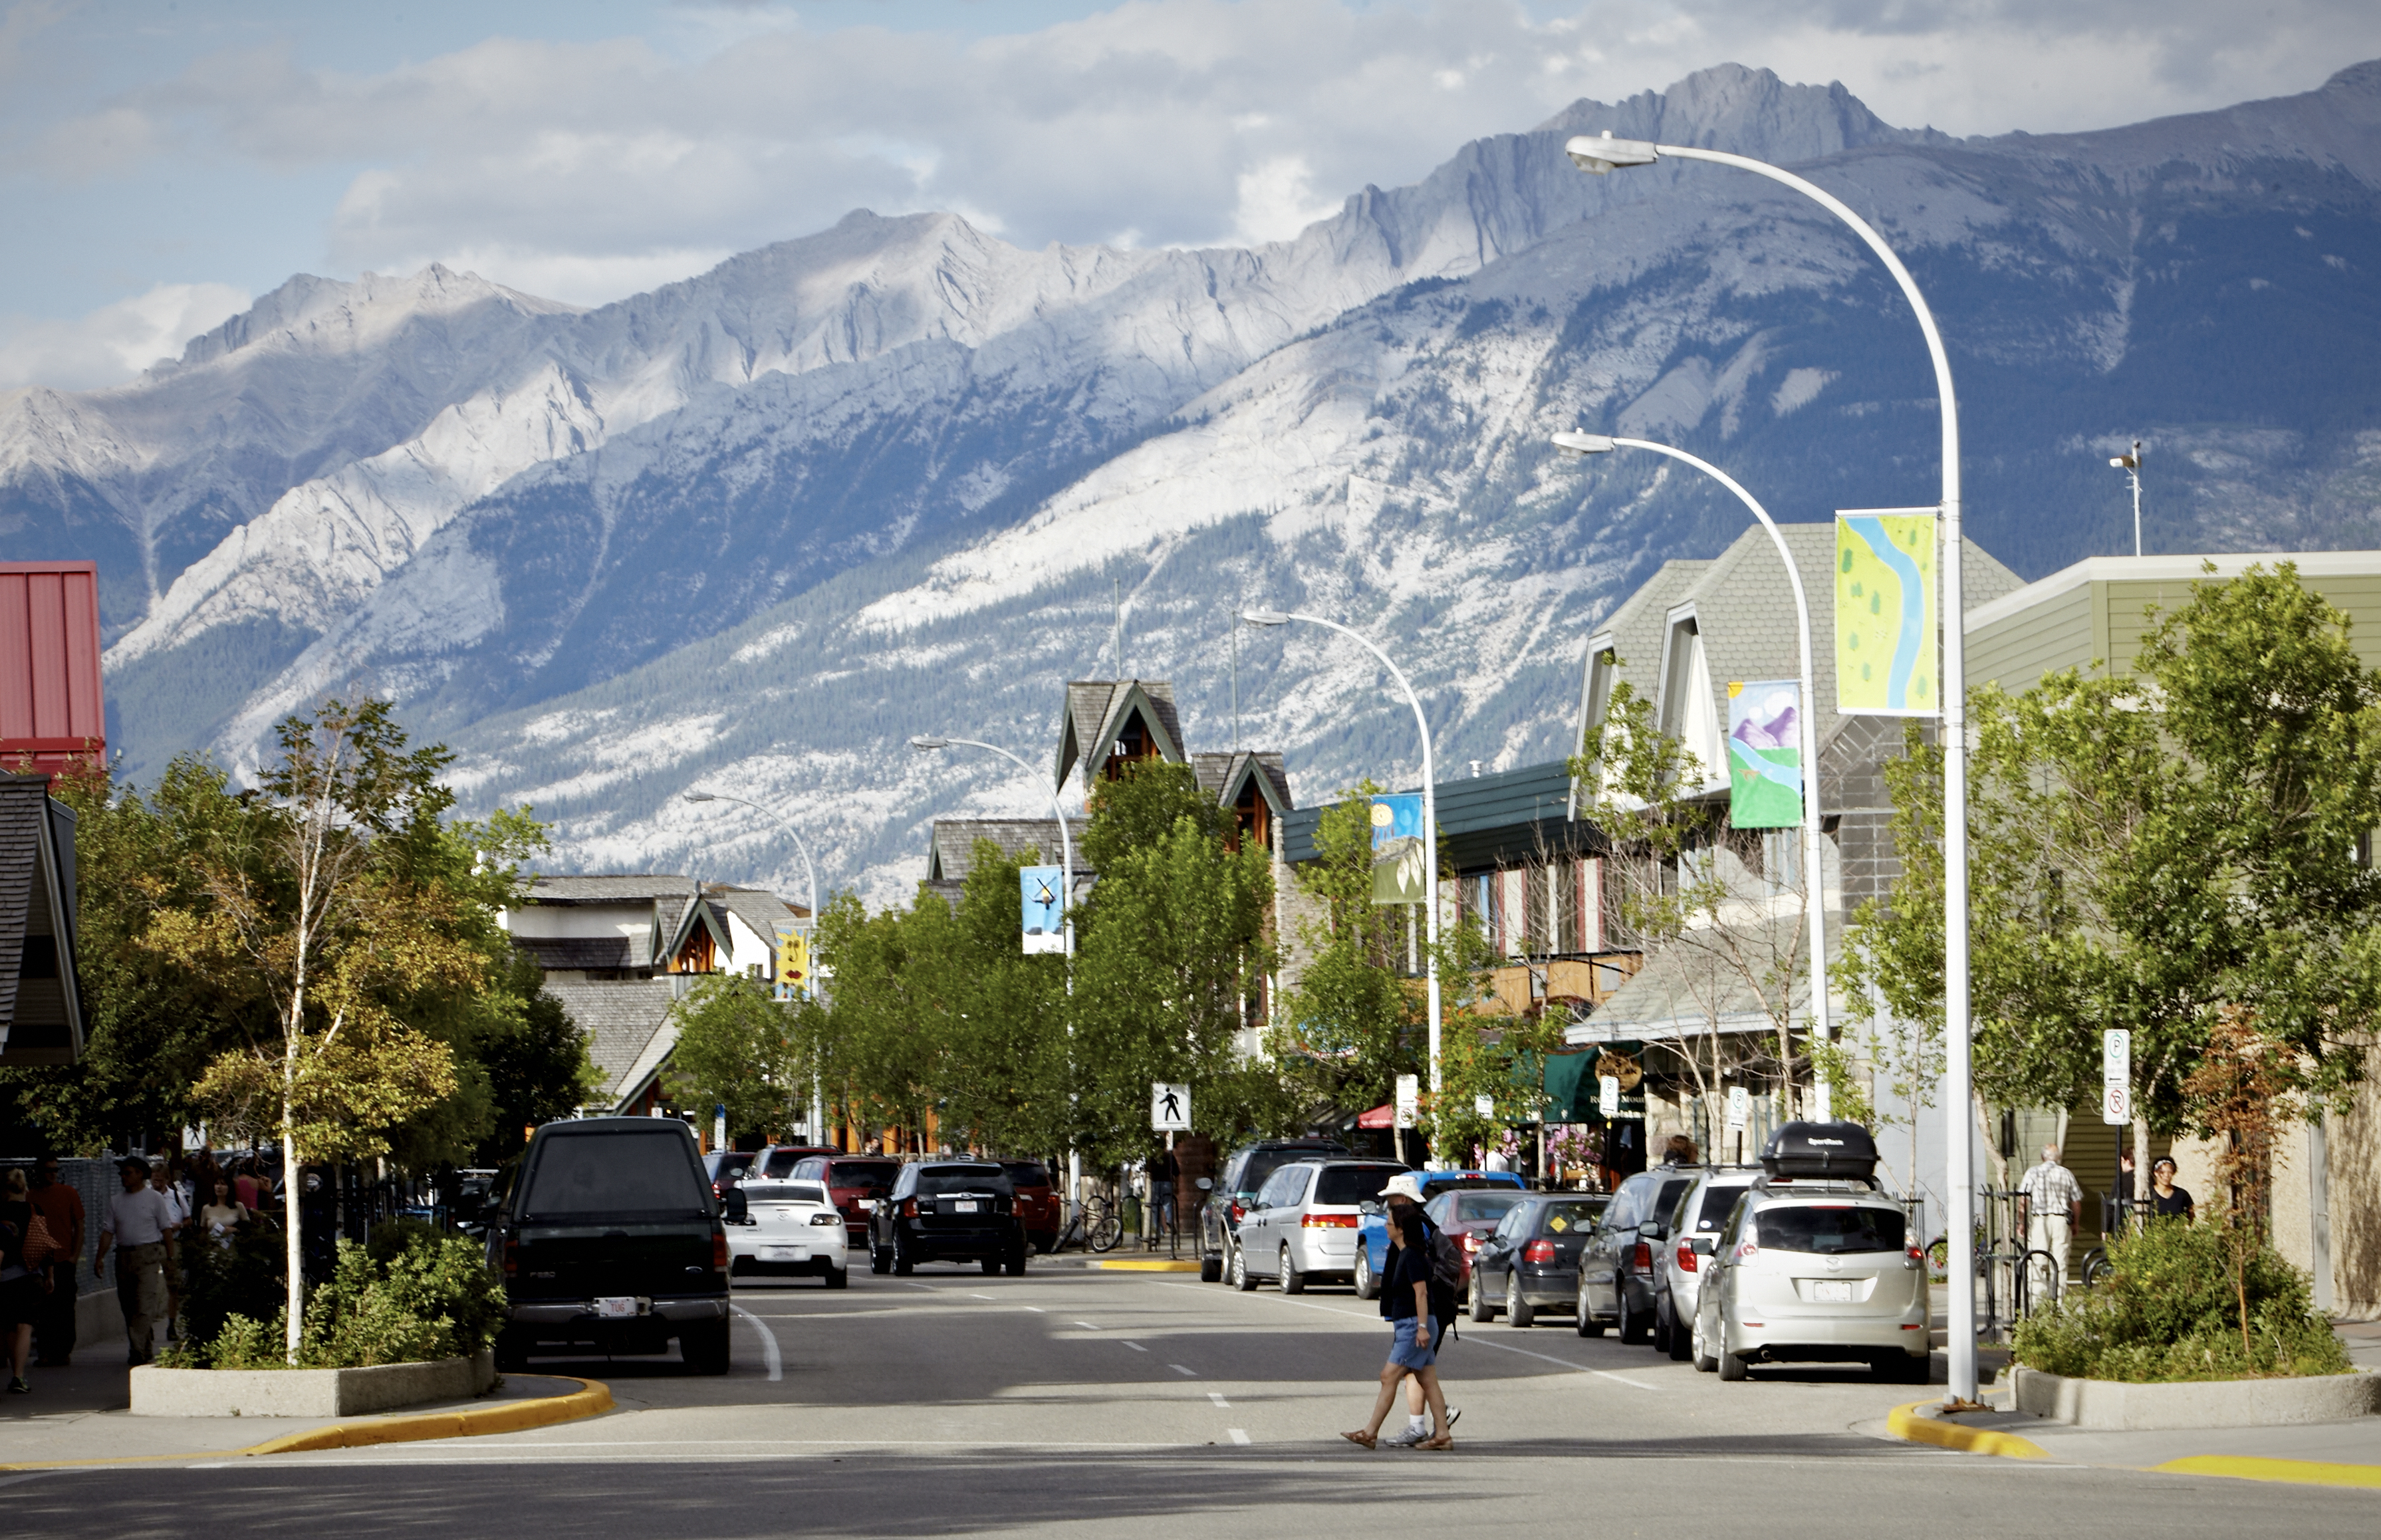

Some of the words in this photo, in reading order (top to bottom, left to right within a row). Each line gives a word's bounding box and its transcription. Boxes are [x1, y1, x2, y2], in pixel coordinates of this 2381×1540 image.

[2114, 1039, 2120, 1052] P
[1737, 1094, 1741, 1104] P
[611, 1303, 625, 1312] TUG
